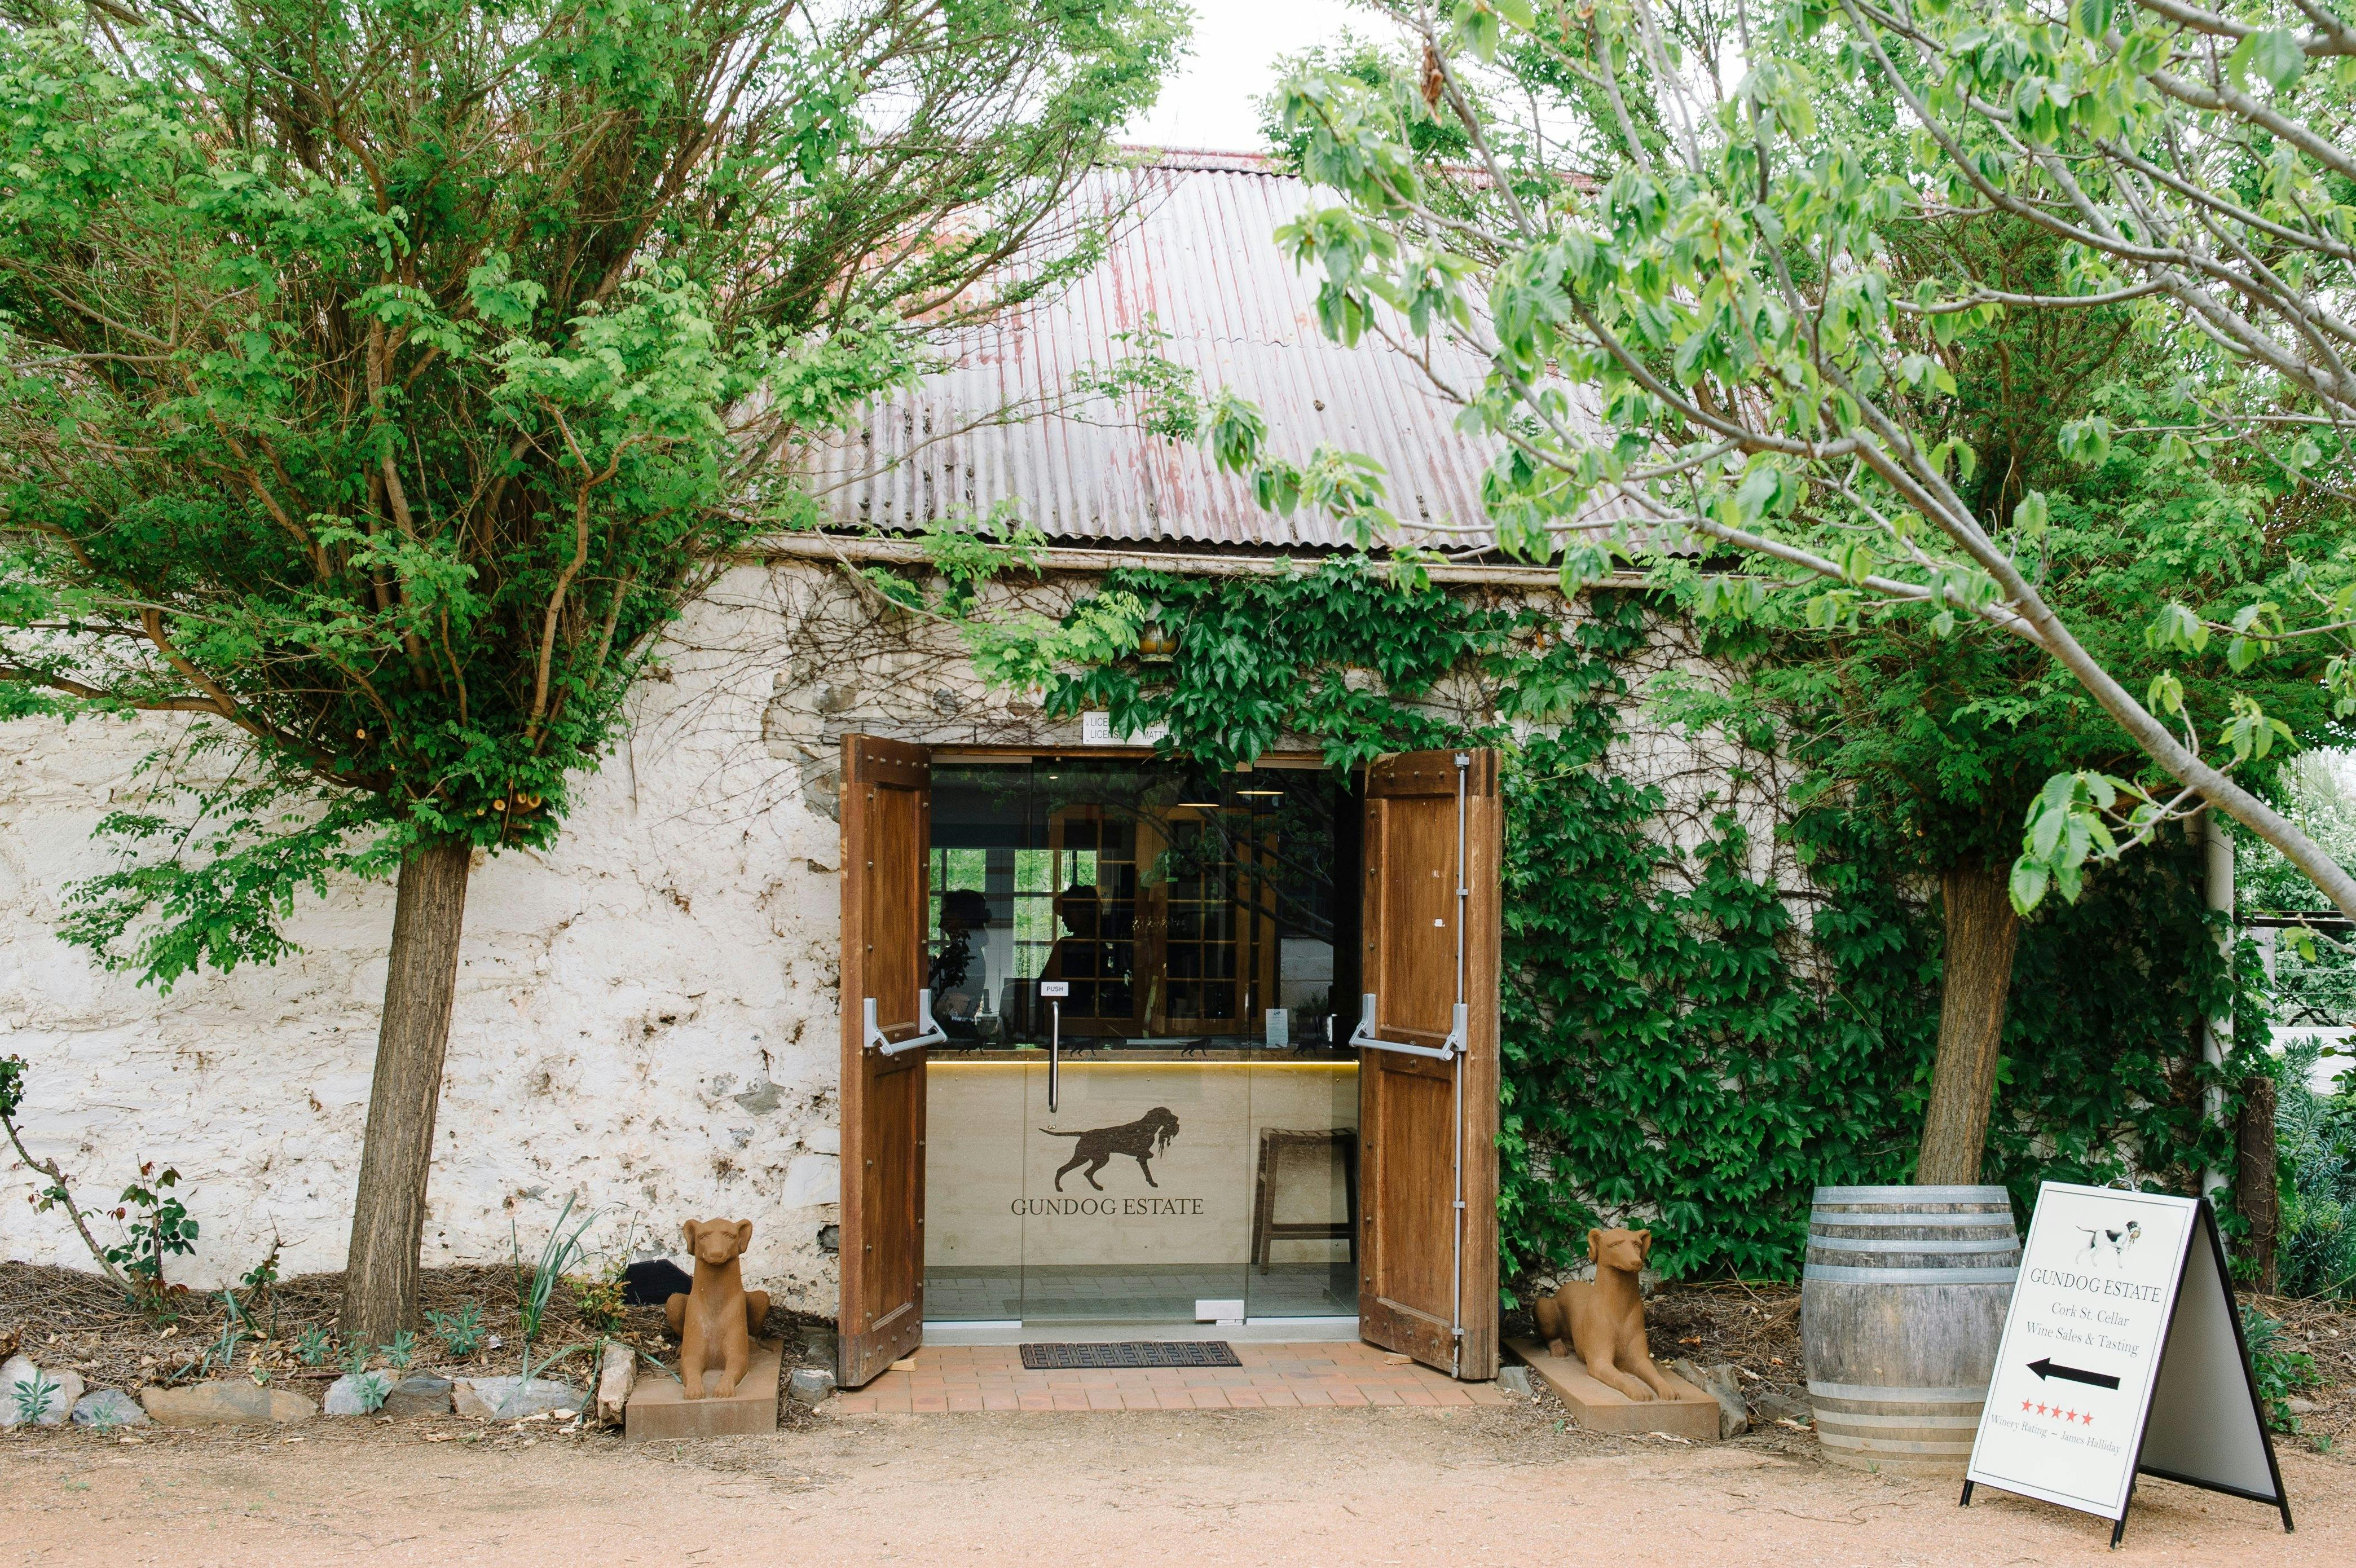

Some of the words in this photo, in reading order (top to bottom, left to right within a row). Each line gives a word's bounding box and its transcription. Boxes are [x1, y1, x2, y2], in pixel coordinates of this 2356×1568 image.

[1011, 1198, 1117, 1215] GUNDOG
[1122, 1198, 1204, 1215] ESTATE
[2031, 1268, 2100, 1292] GUNDOG
[2103, 1280, 2161, 1302] ESTATE
[2051, 1302, 2077, 1318] Cork
[2080, 1307, 2093, 1320] St.
[2097, 1310, 2129, 1326] Cellar
[2027, 1321, 2054, 1338] Wine
[2055, 1327, 2081, 1343] Sales
[2085, 1333, 2094, 1345] &
[2098, 1334, 2139, 1358] Tasting
[1992, 1414, 2020, 1432] Winery
[2022, 1421, 2048, 1439] Rating
[2060, 1430, 2084, 1445] James
[2086, 1437, 2121, 1456] Halliday
